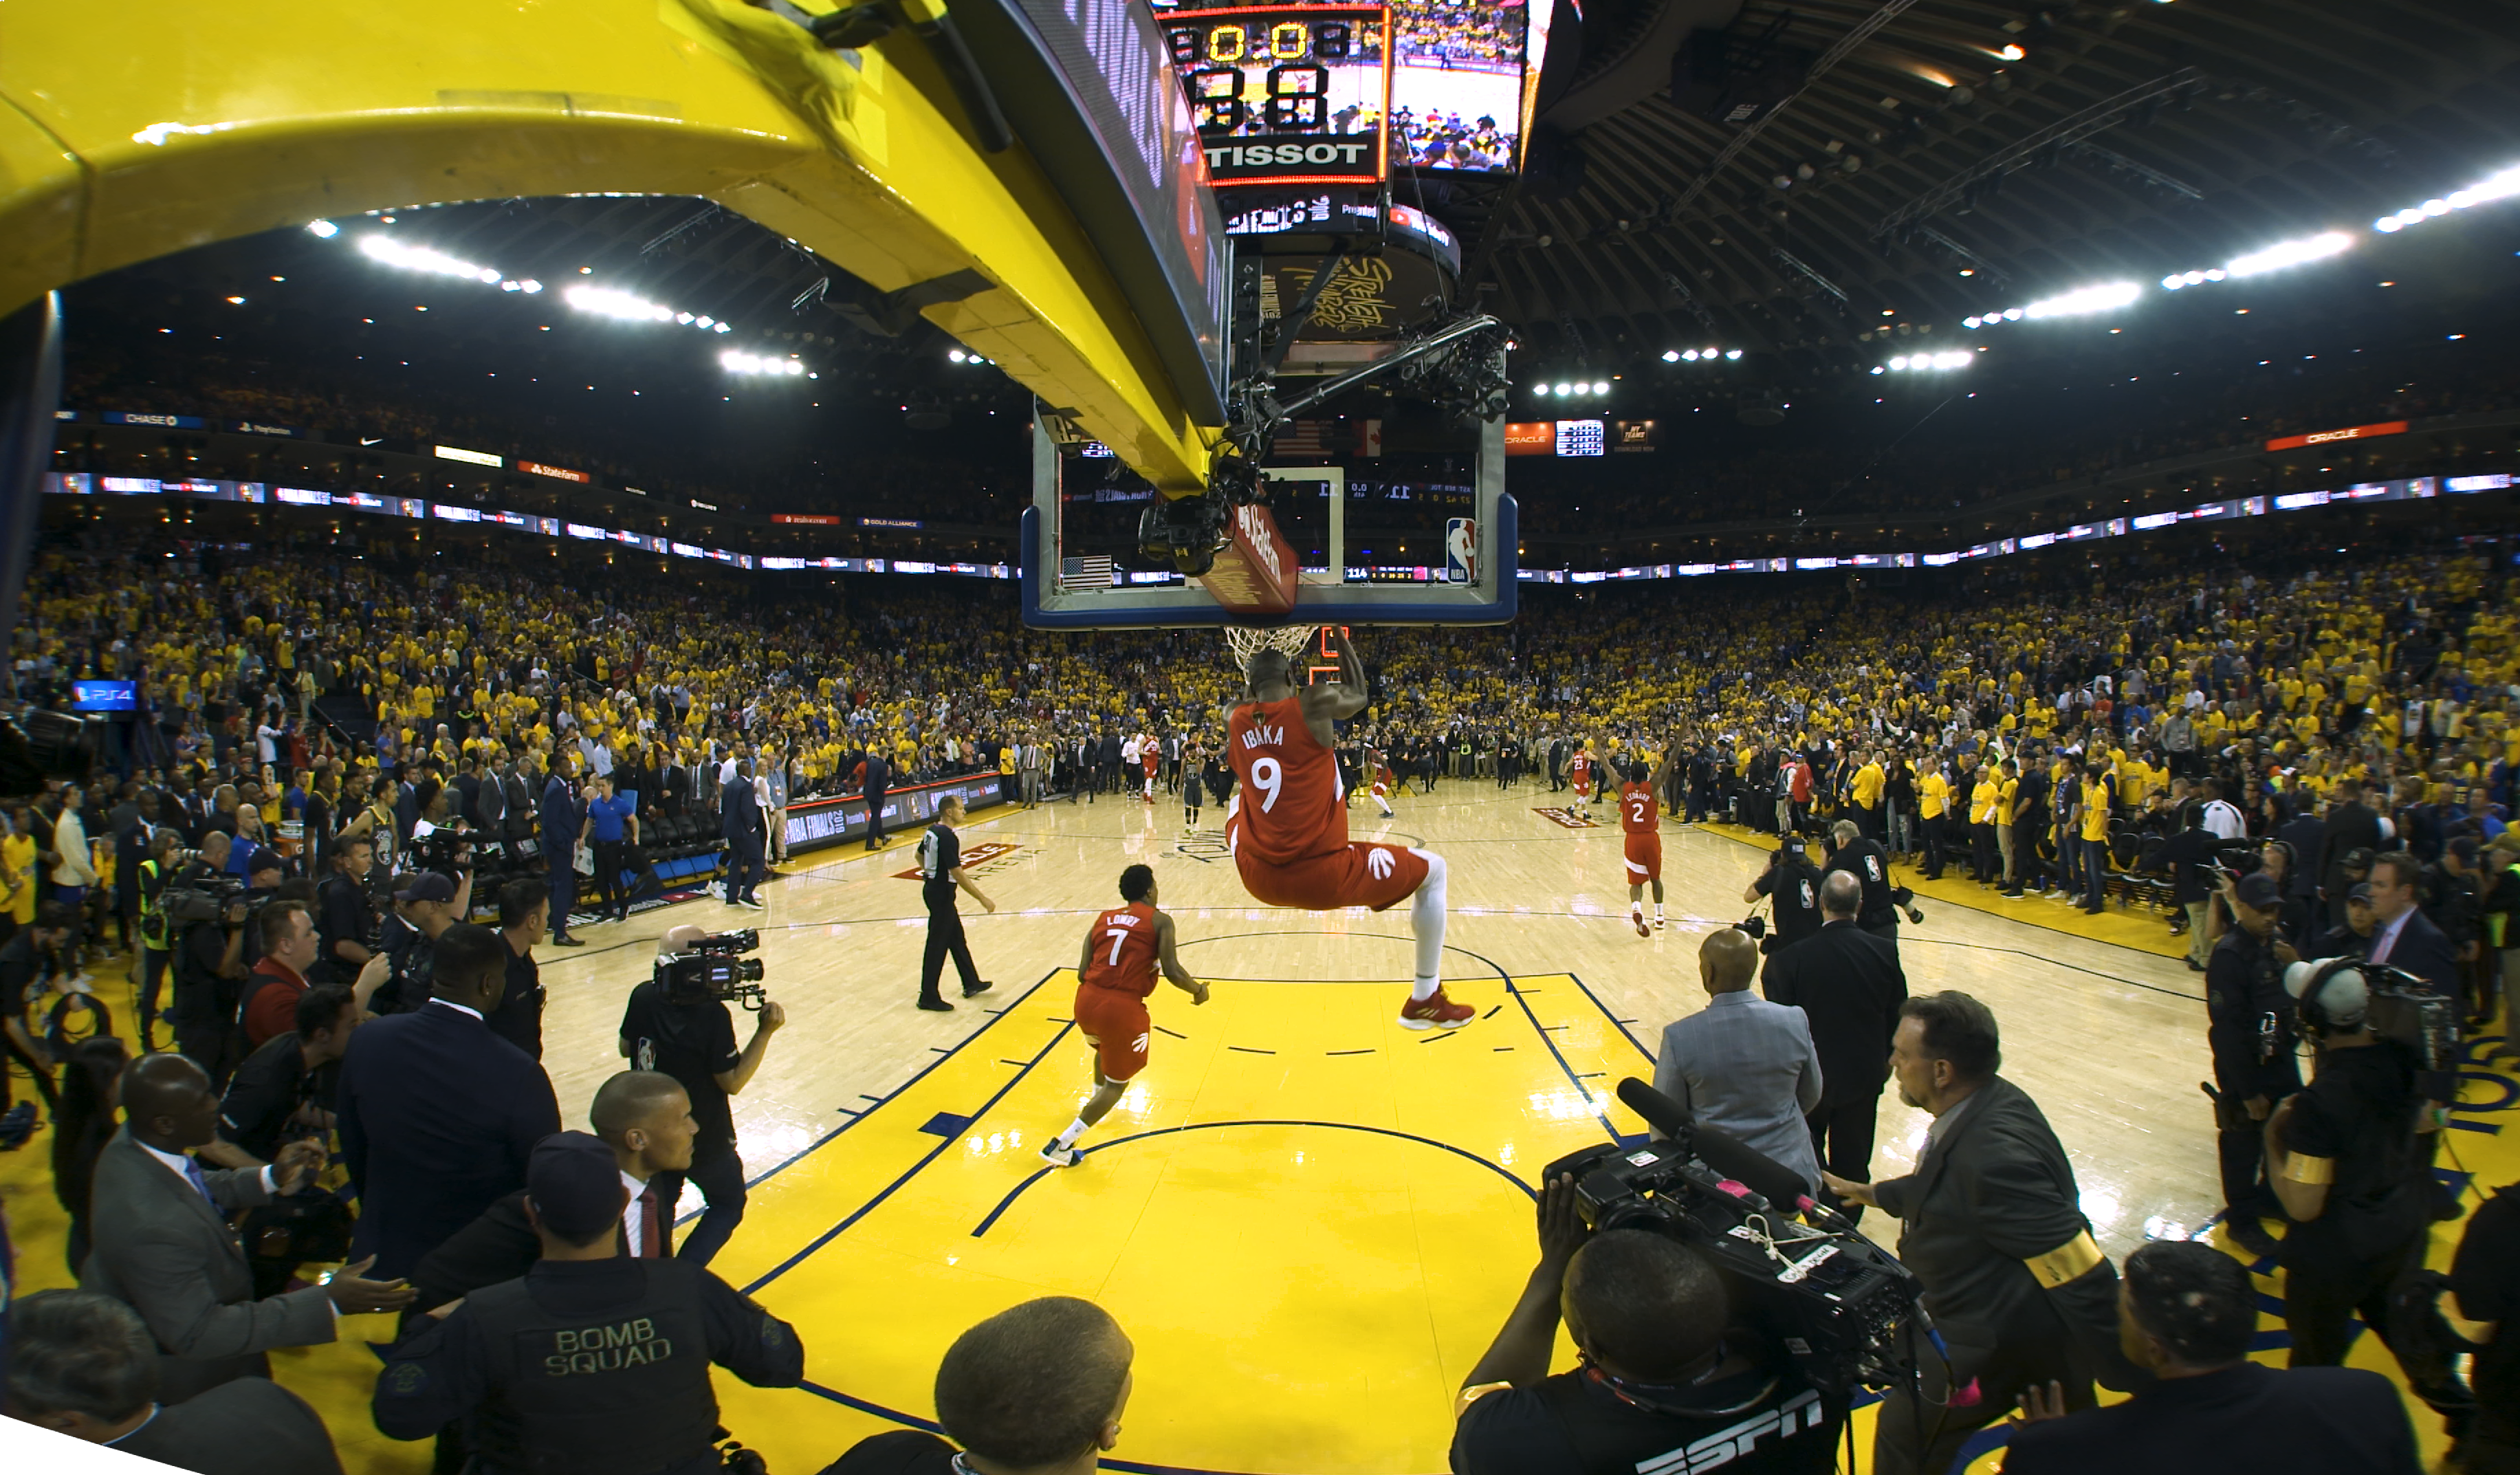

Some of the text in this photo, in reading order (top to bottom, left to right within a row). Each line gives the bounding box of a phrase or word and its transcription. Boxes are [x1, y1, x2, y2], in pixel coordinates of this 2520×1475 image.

[1205, 144, 1368, 168] TISSOT
[124, 414, 166, 425] CHASE
[2305, 428, 2359, 444] ORACLE
[1347, 568, 1368, 578] 114
[1451, 569, 1465, 580] NBA
[91, 690, 135, 700] PS4
[1242, 725, 1284, 750] IBAKA
[1574, 759, 1584, 769] 23
[1251, 757, 1282, 813] 9
[1625, 793, 1650, 803] LEONARD
[1632, 802, 1644, 822] 2
[787, 809, 845, 843] NBA FINALS 2019
[1106, 914, 1141, 927] LOWRY
[1106, 928, 1129, 966] 7
[555, 1318, 655, 1354] BOMB
[545, 1337, 672, 1377] SQUAD
[1634, 1388, 1823, 1475] ESPN
